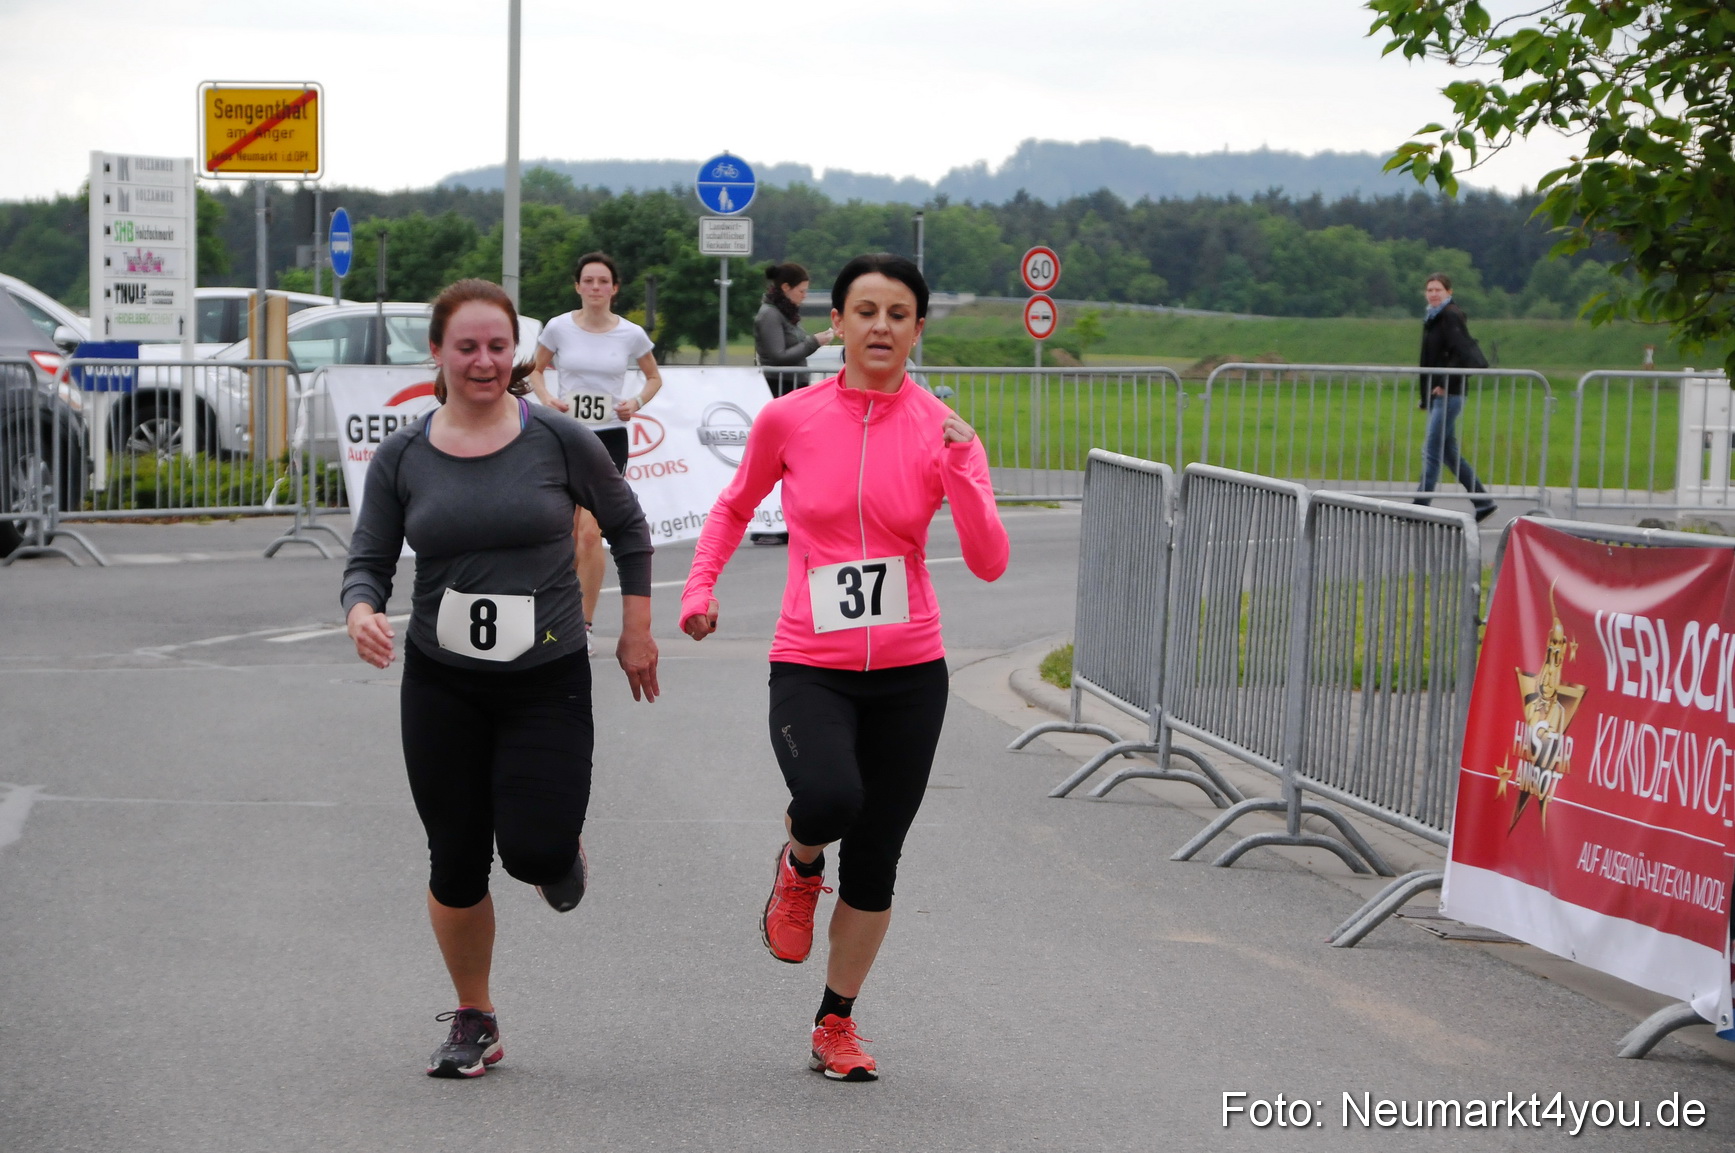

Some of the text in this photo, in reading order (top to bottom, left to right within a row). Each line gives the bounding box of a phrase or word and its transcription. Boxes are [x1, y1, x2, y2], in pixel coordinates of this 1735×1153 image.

[213, 98, 308, 125] Sengenthal
[227, 126, 295, 142] am Anger
[236, 151, 278, 161] Neumarkt
[114, 220, 134, 243] SHB
[1030, 260, 1051, 279] 60
[114, 282, 147, 304] THULE
[573, 394, 605, 421] 135
[705, 430, 750, 440] NISSA
[624, 458, 688, 481] OTORS
[836, 562, 888, 619] 37
[470, 598, 498, 651] 8
[1577, 842, 1602, 873] AUF
